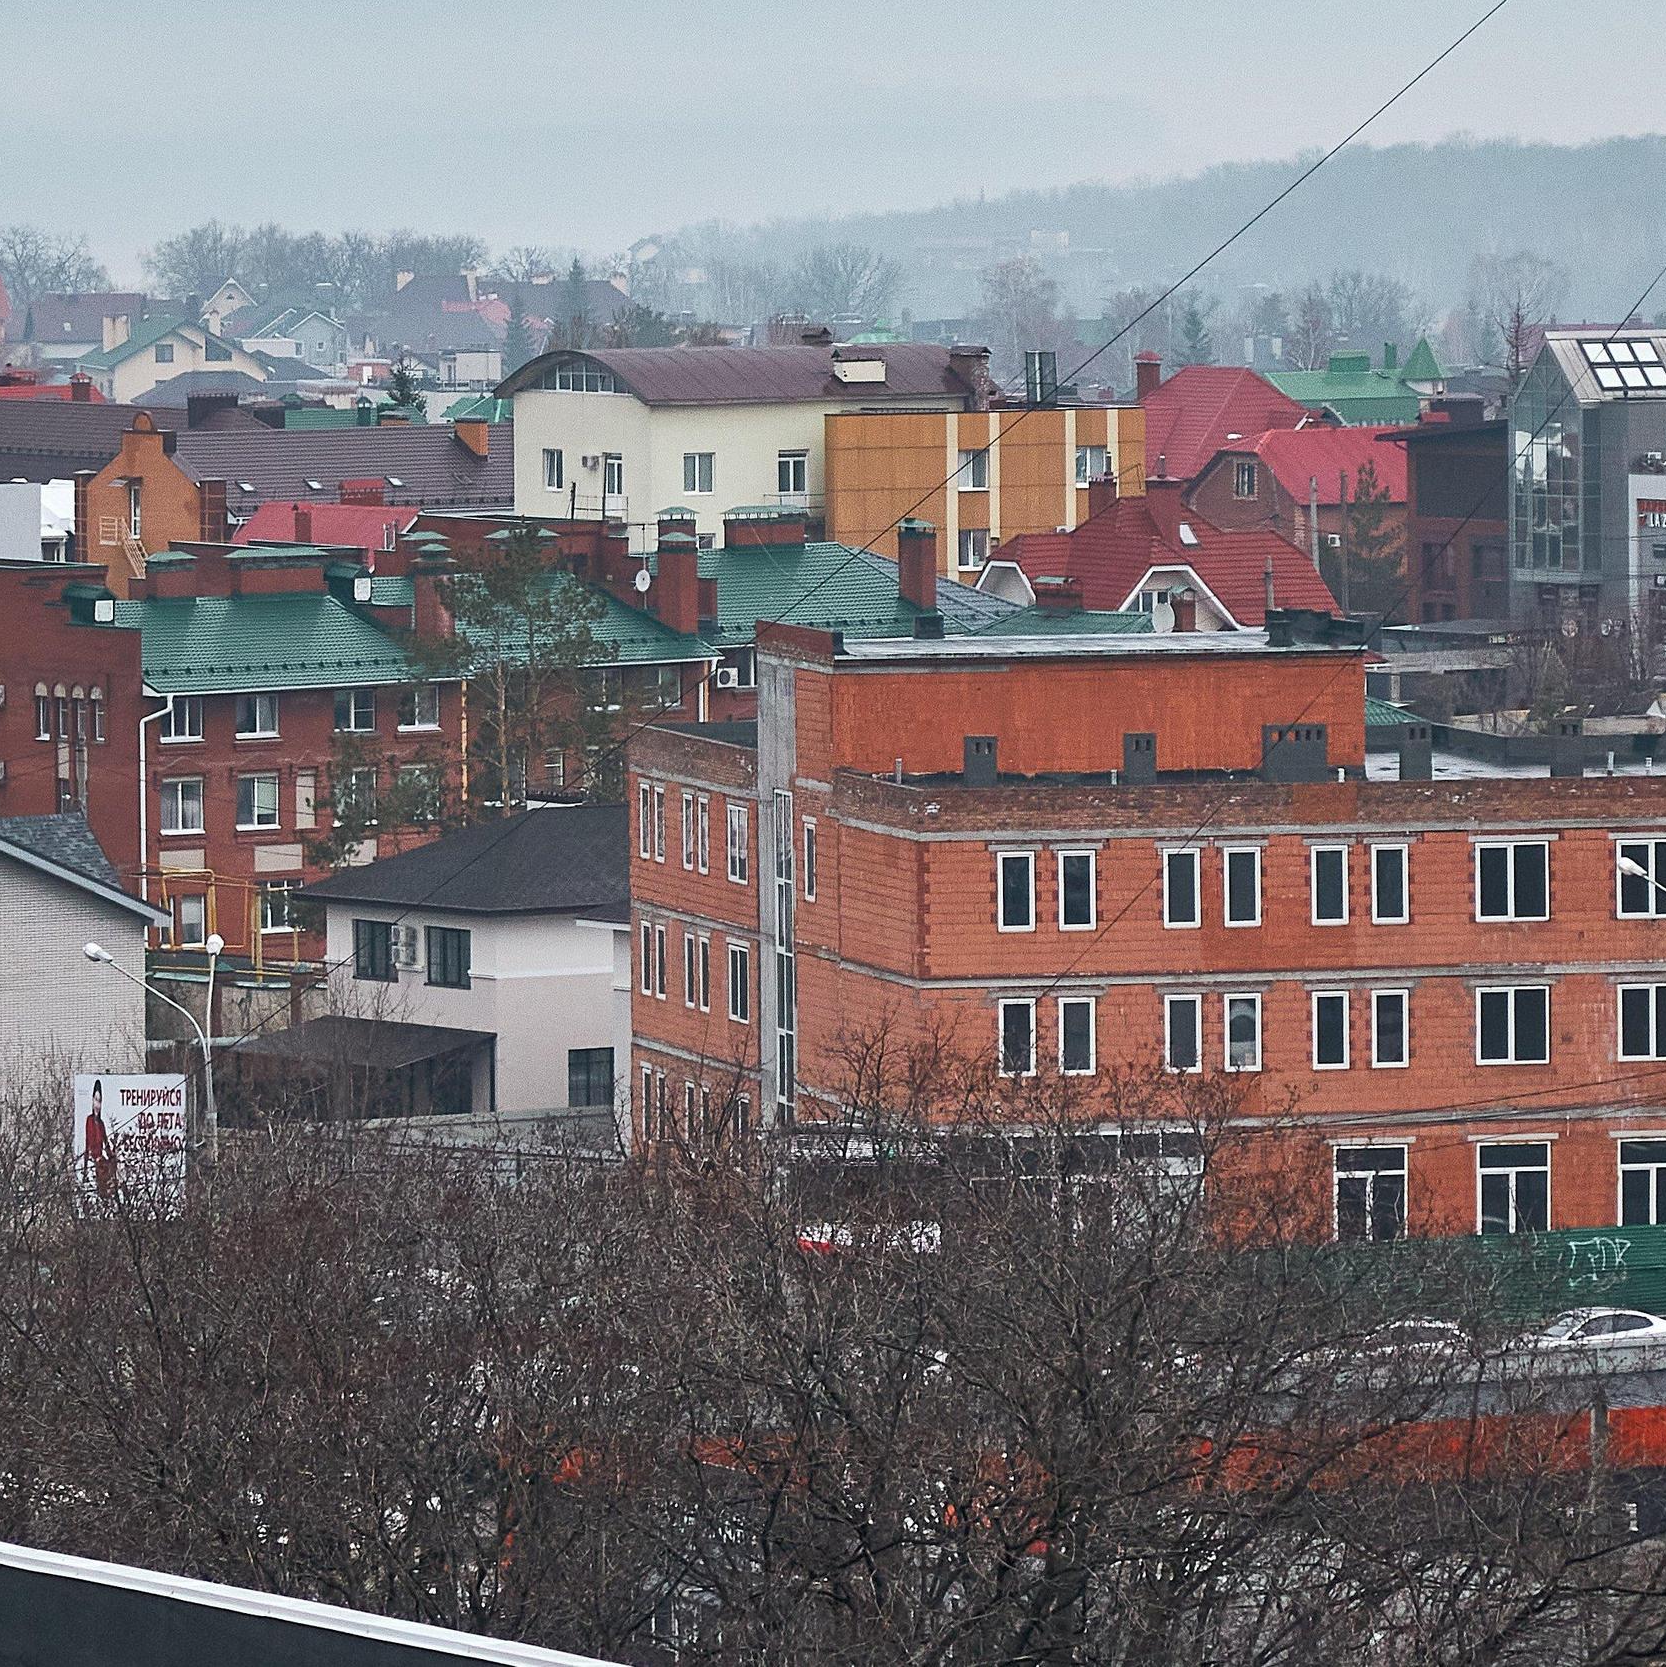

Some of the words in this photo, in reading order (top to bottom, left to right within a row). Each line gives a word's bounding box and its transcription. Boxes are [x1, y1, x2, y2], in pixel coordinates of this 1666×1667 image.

[120, 1087, 182, 1106] ТРЕНИРУЙСЯ
[138, 1112, 154, 1133] ДО
[156, 1112, 182, 1130] ЛЕТА
